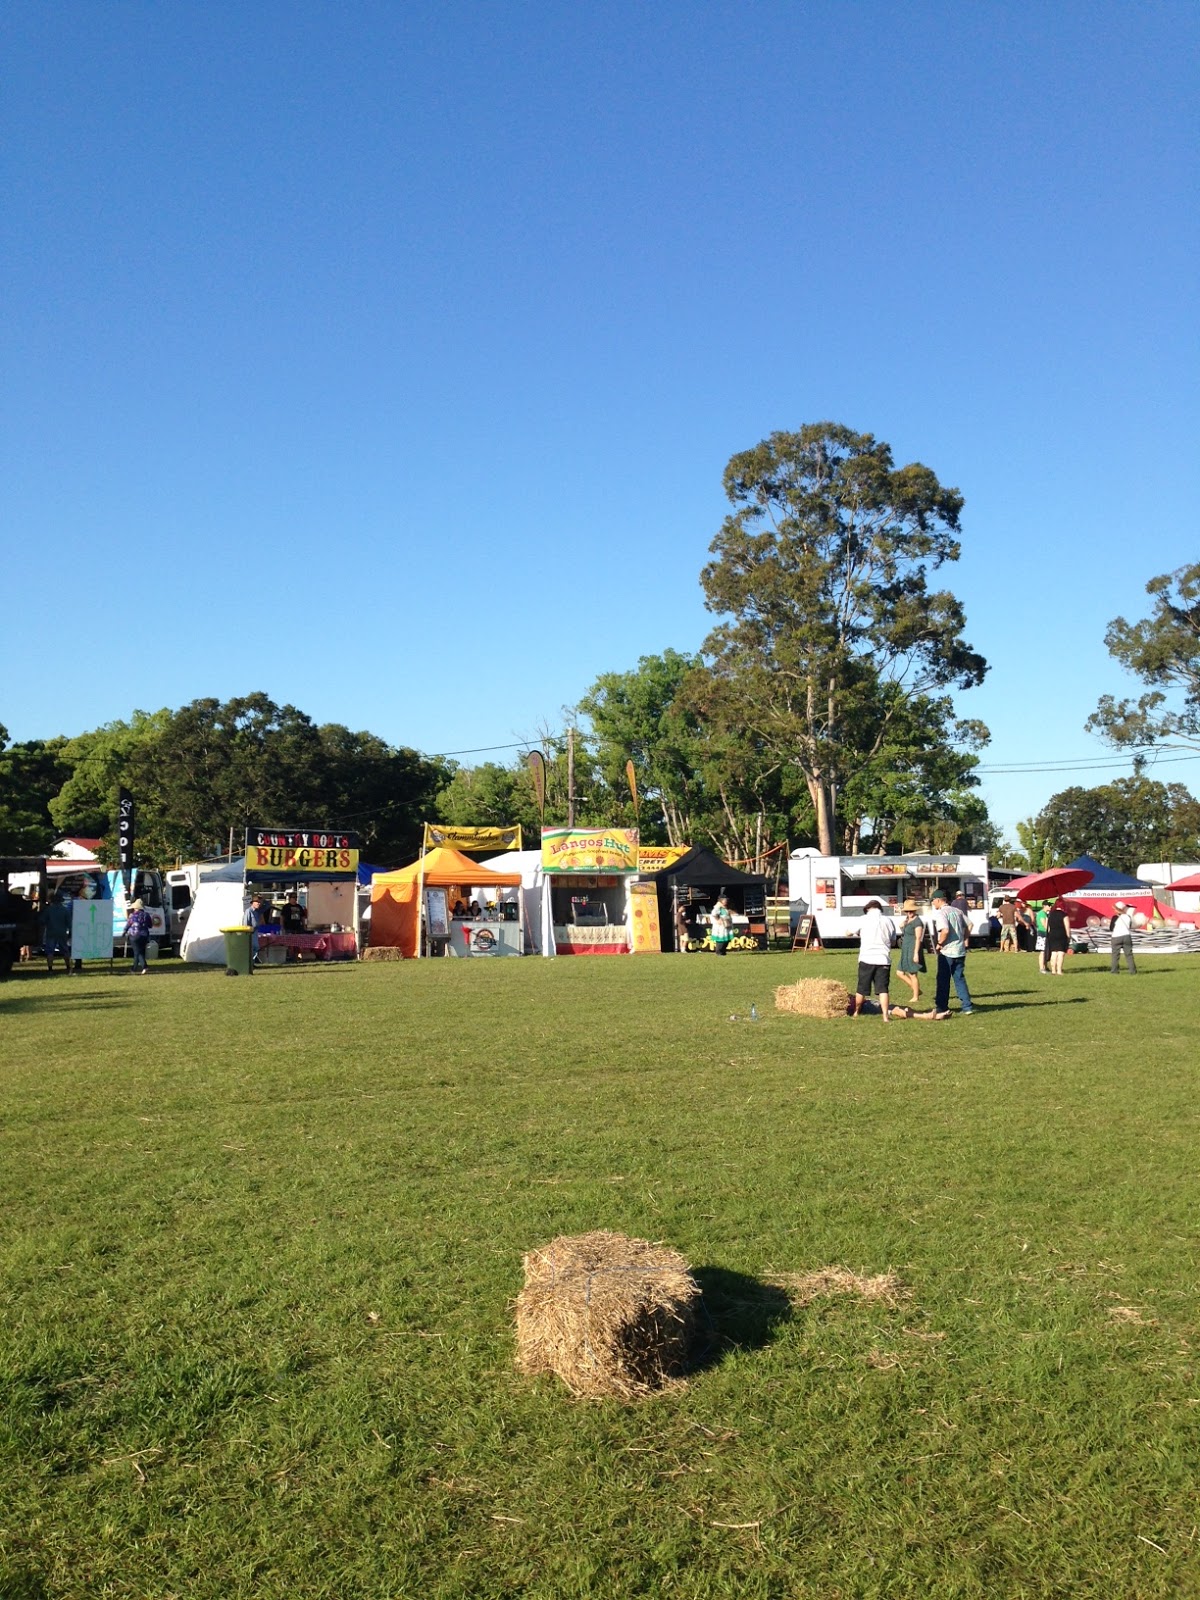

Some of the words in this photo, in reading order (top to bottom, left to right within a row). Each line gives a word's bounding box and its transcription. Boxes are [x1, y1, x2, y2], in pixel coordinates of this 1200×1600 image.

[257, 832, 309, 847] COUNTRY
[312, 834, 349, 848] ROOTS
[256, 847, 351, 868] BURGERS
